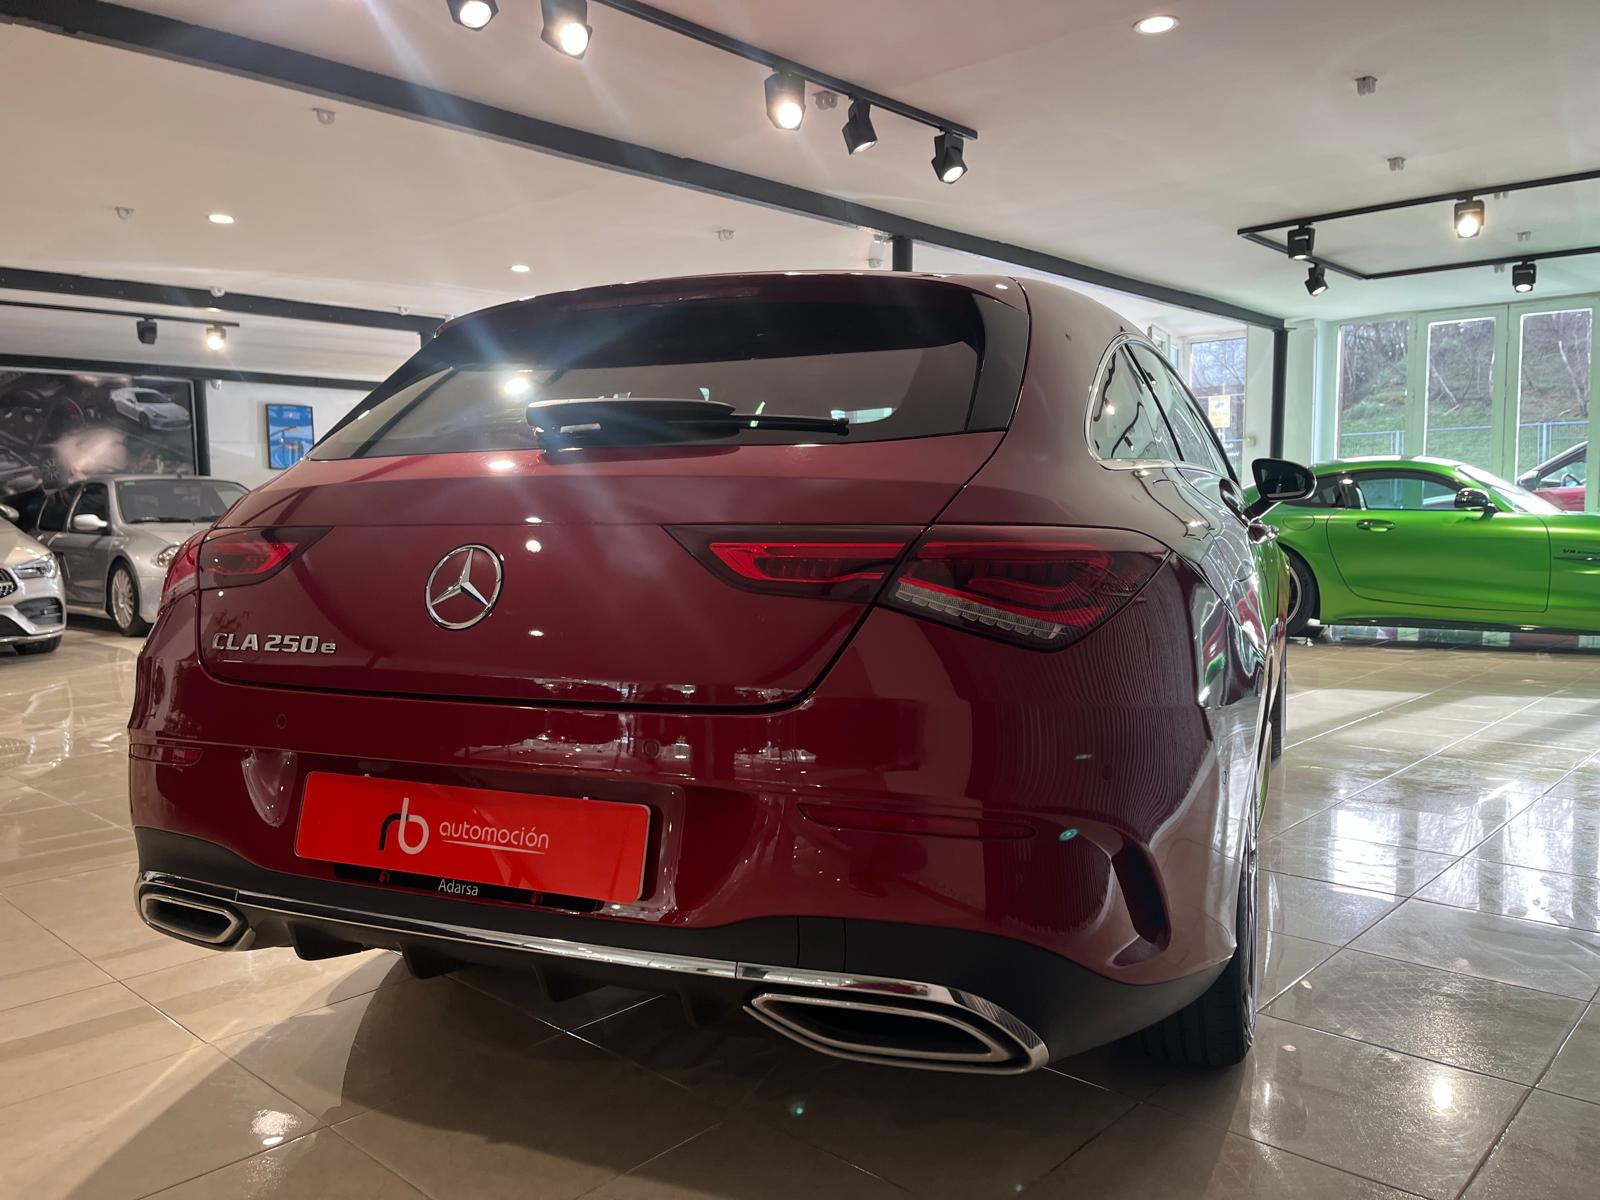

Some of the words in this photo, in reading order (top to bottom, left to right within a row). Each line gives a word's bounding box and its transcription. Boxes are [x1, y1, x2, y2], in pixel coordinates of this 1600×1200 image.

[212, 632, 259, 652] CLA
[439, 820, 550, 849] automoción
[437, 878, 479, 897] Adarsa
